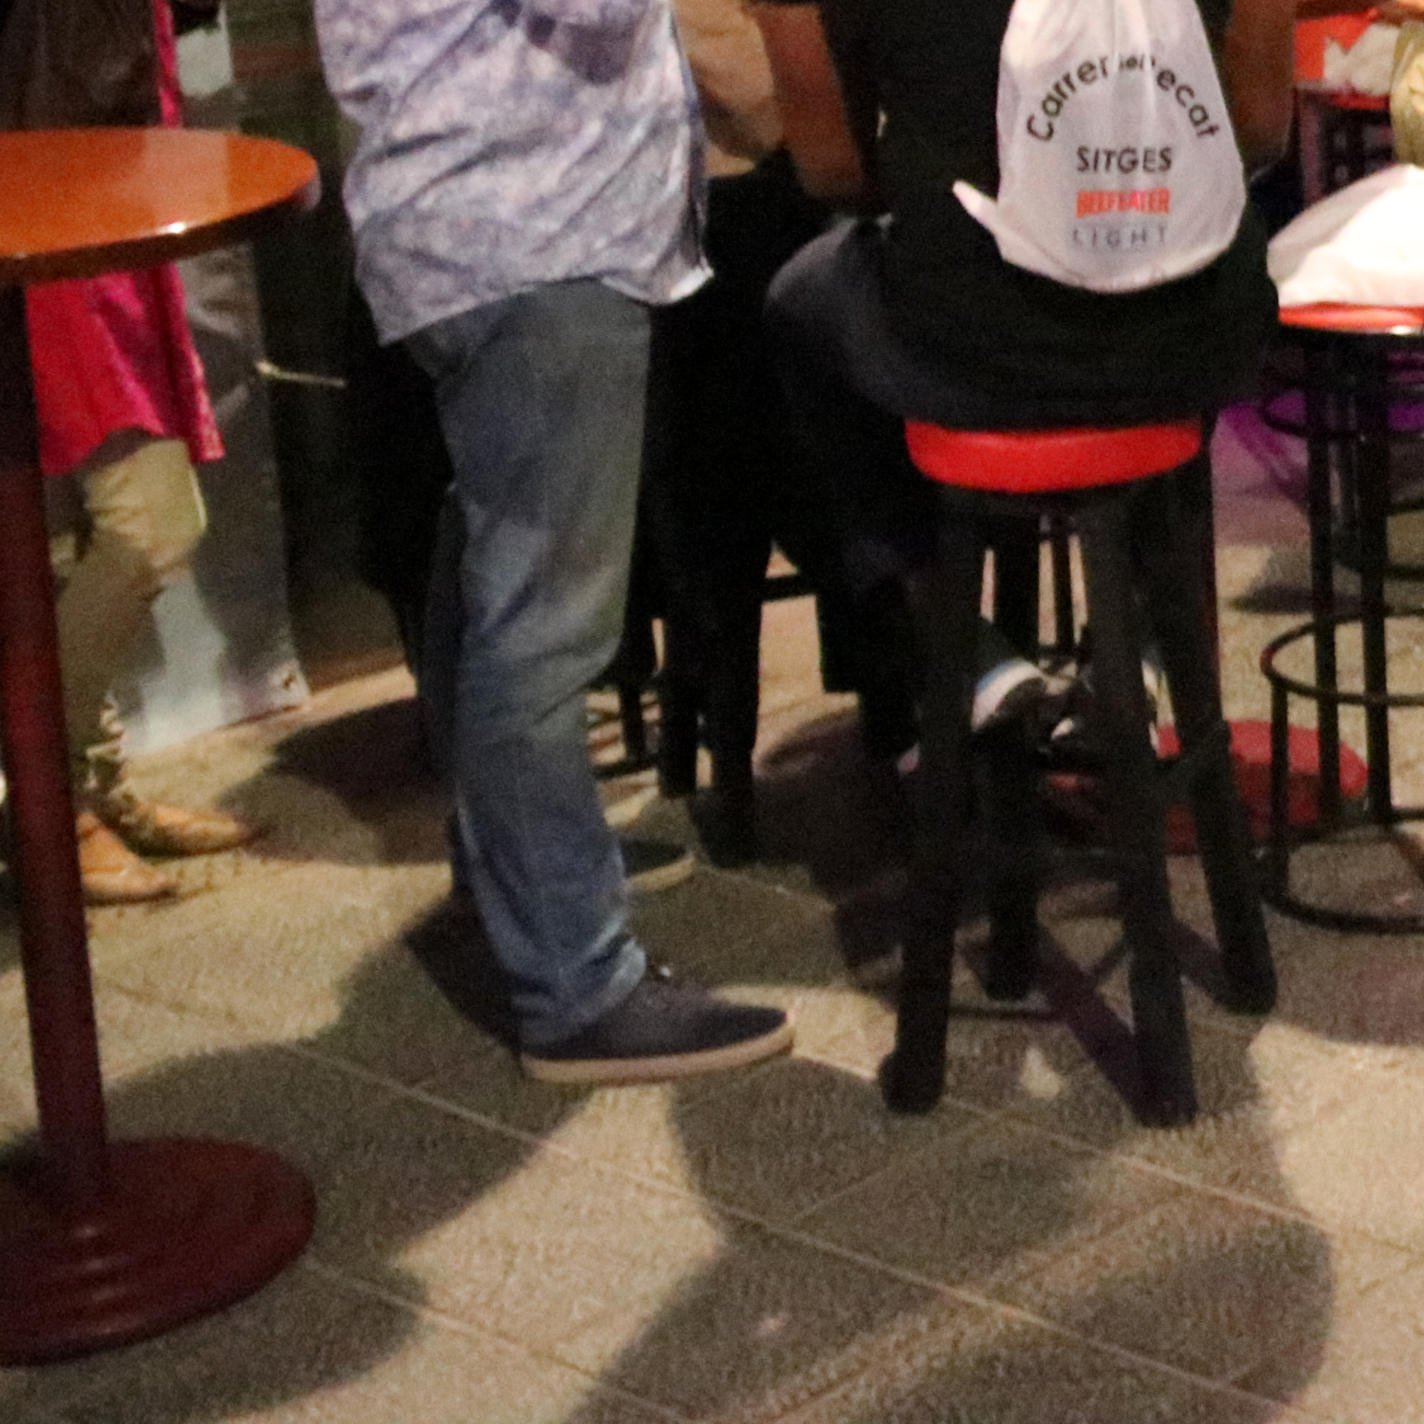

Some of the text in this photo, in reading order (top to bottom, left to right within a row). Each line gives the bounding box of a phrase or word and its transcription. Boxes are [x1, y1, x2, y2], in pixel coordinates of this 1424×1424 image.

[1026, 55, 1108, 141] Carrer
[1151, 54, 1220, 138] ecat
[1075, 144, 1173, 174] SITGES
